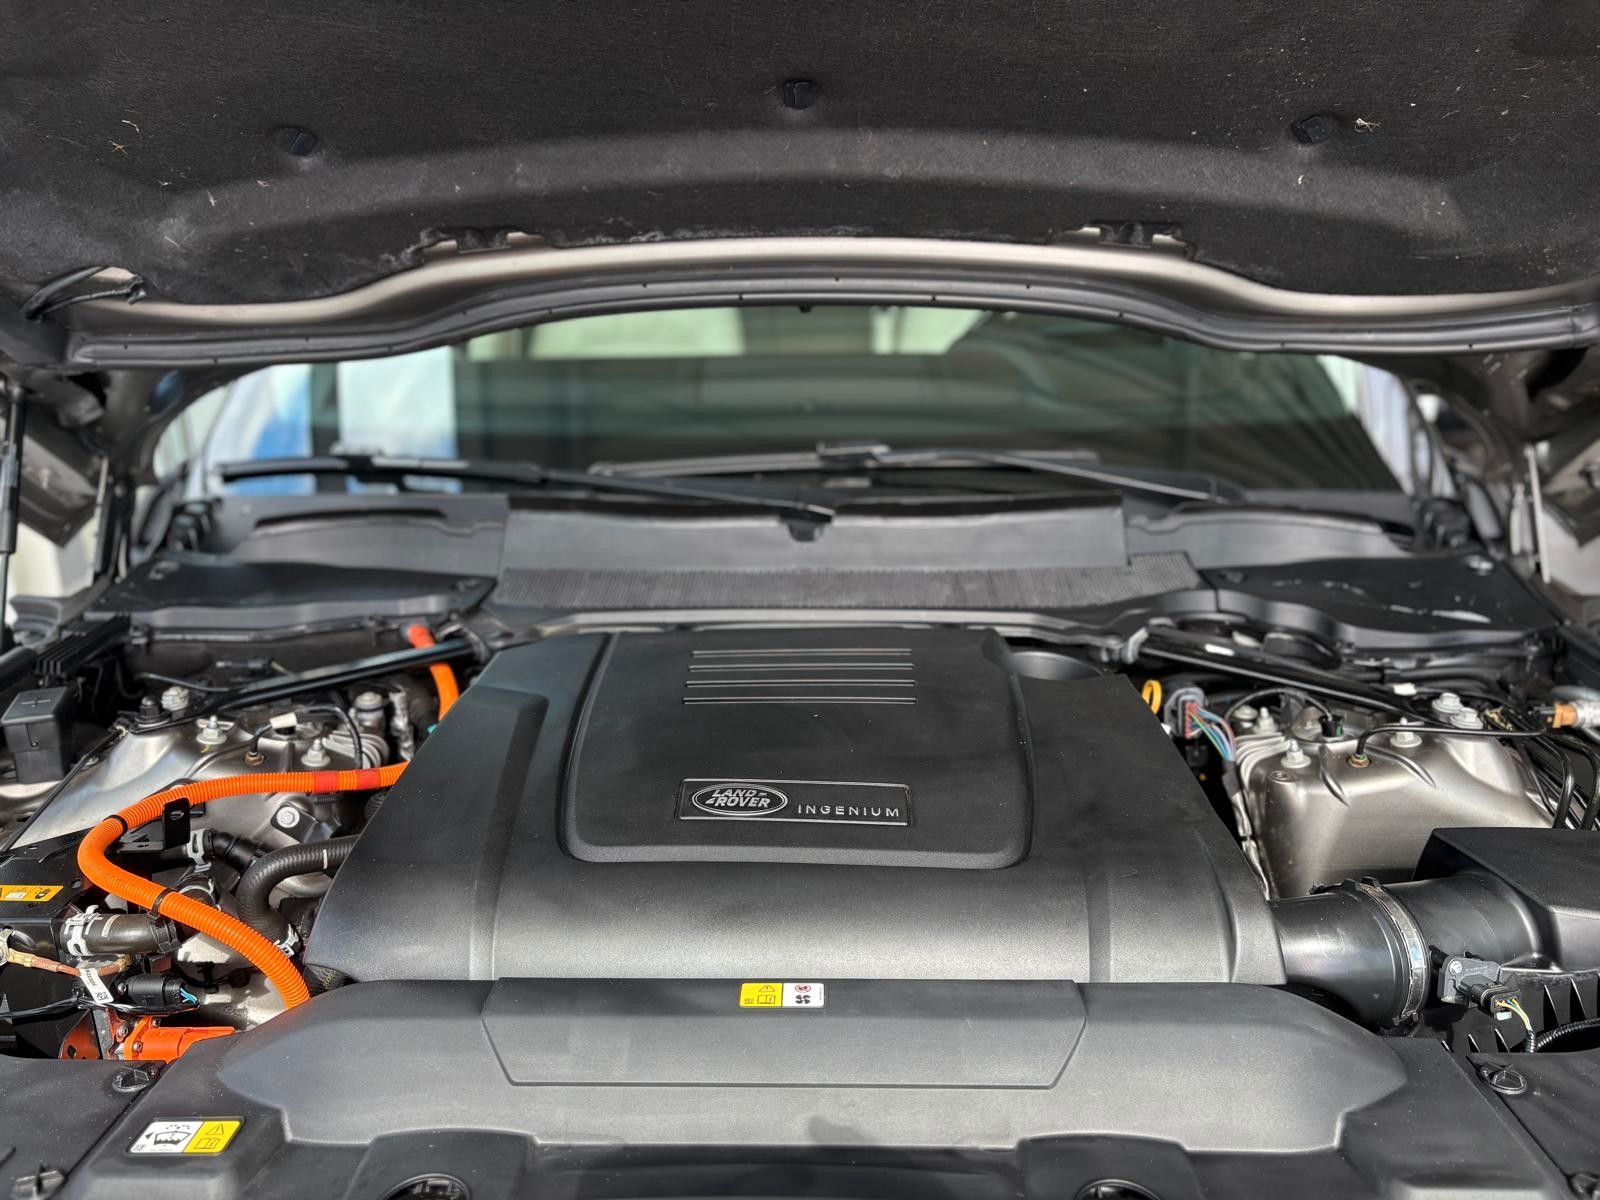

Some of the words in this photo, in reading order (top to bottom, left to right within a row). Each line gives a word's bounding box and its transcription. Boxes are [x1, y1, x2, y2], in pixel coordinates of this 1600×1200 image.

[712, 788, 757, 798] LAND
[713, 796, 771, 808] ROVER
[797, 804, 900, 817] INGENIUM
